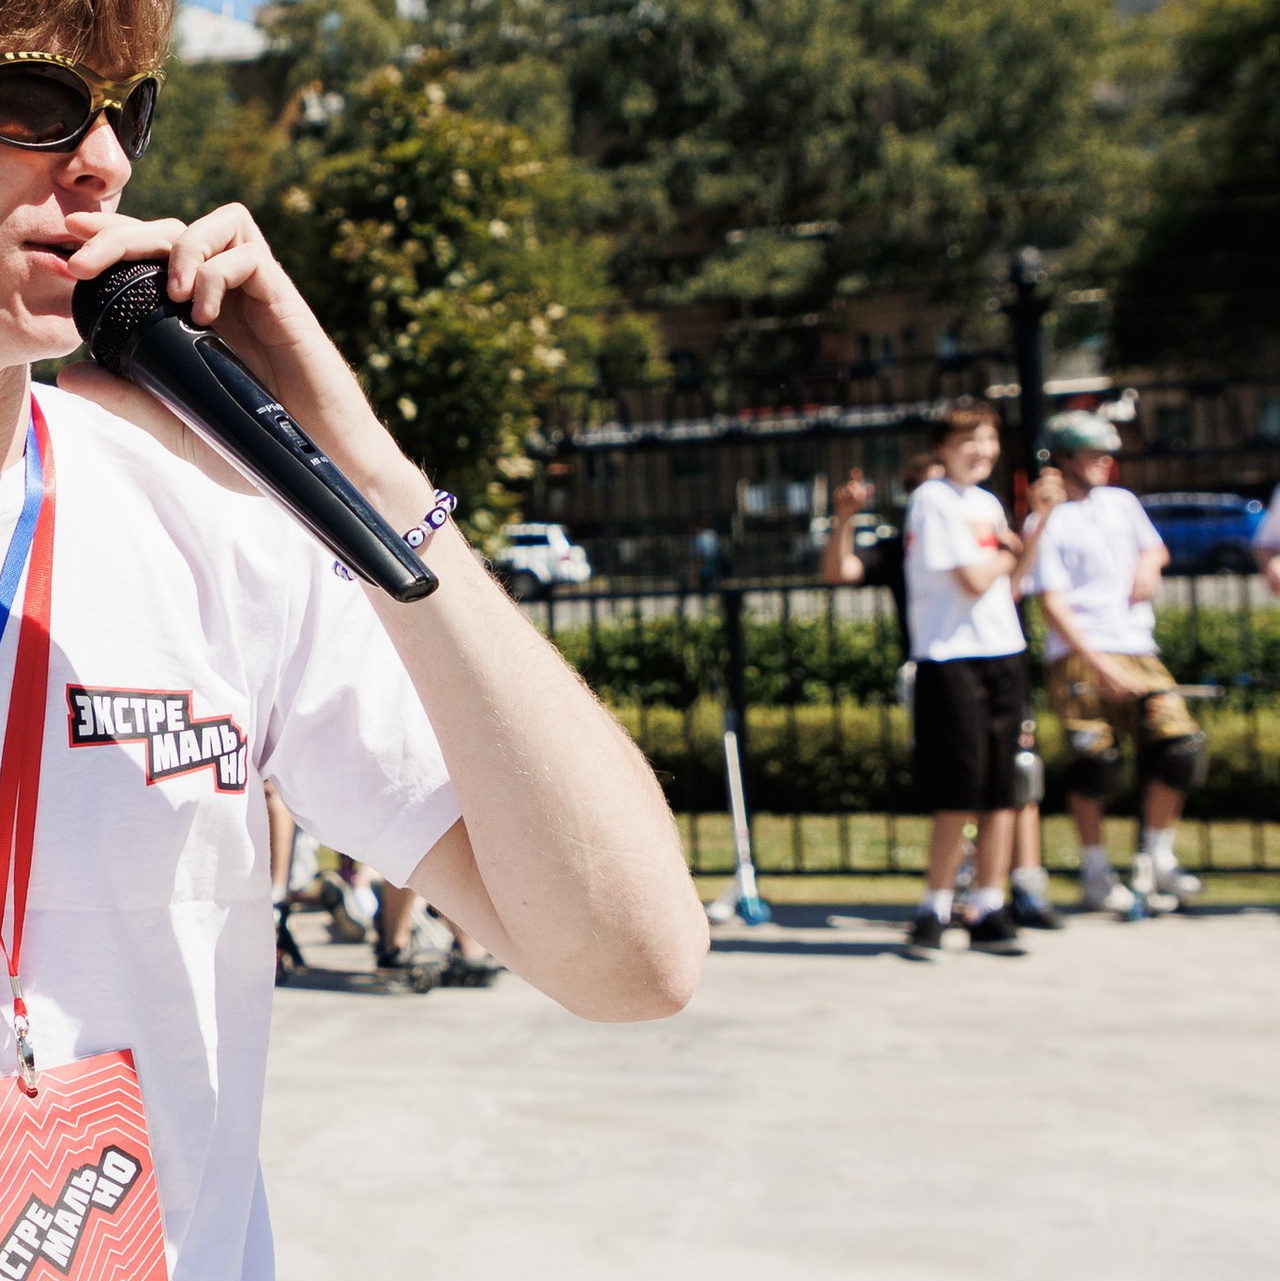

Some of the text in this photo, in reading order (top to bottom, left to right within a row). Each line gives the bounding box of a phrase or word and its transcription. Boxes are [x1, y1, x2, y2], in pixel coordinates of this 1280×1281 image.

[75, 695, 185, 736] ЭКСТРЕ
[152, 725, 238, 773] МАЛЬ
[92, 1150, 137, 1208] НО
[41, 1168, 98, 1267] МАЛЬ
